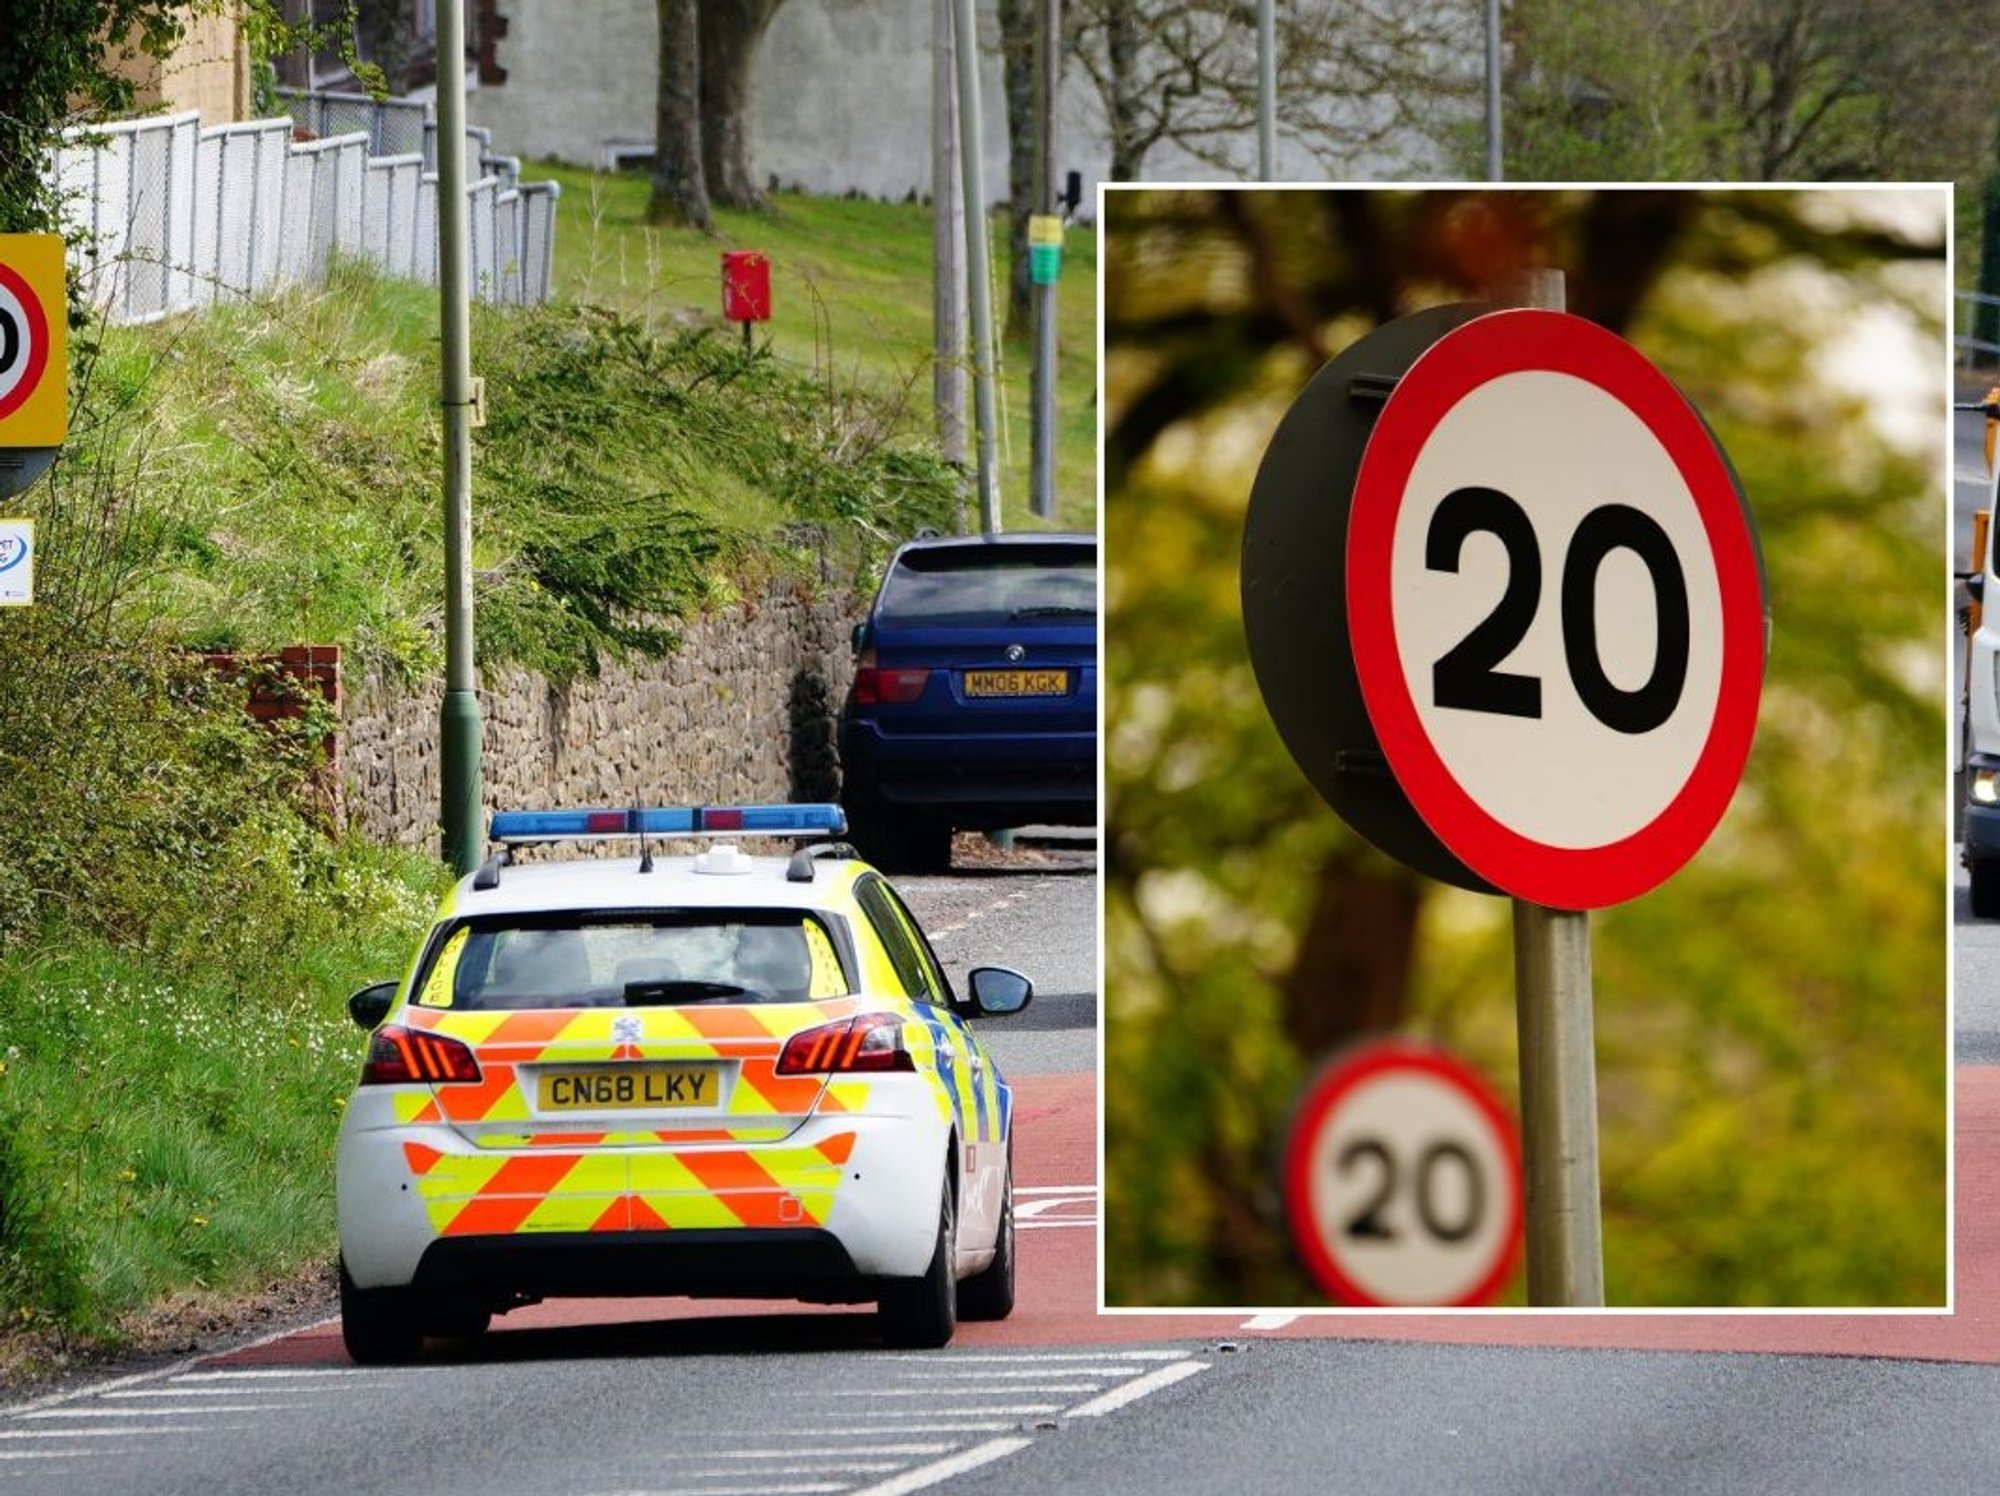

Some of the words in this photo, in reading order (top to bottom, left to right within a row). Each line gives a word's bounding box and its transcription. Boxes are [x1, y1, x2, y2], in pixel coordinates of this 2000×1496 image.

[1425, 486, 1690, 734] 20
[1023, 673, 1060, 690] KGK
[552, 1076, 634, 1104] CN68
[645, 1073, 706, 1102] LKY
[1336, 1138, 1487, 1245] 20
